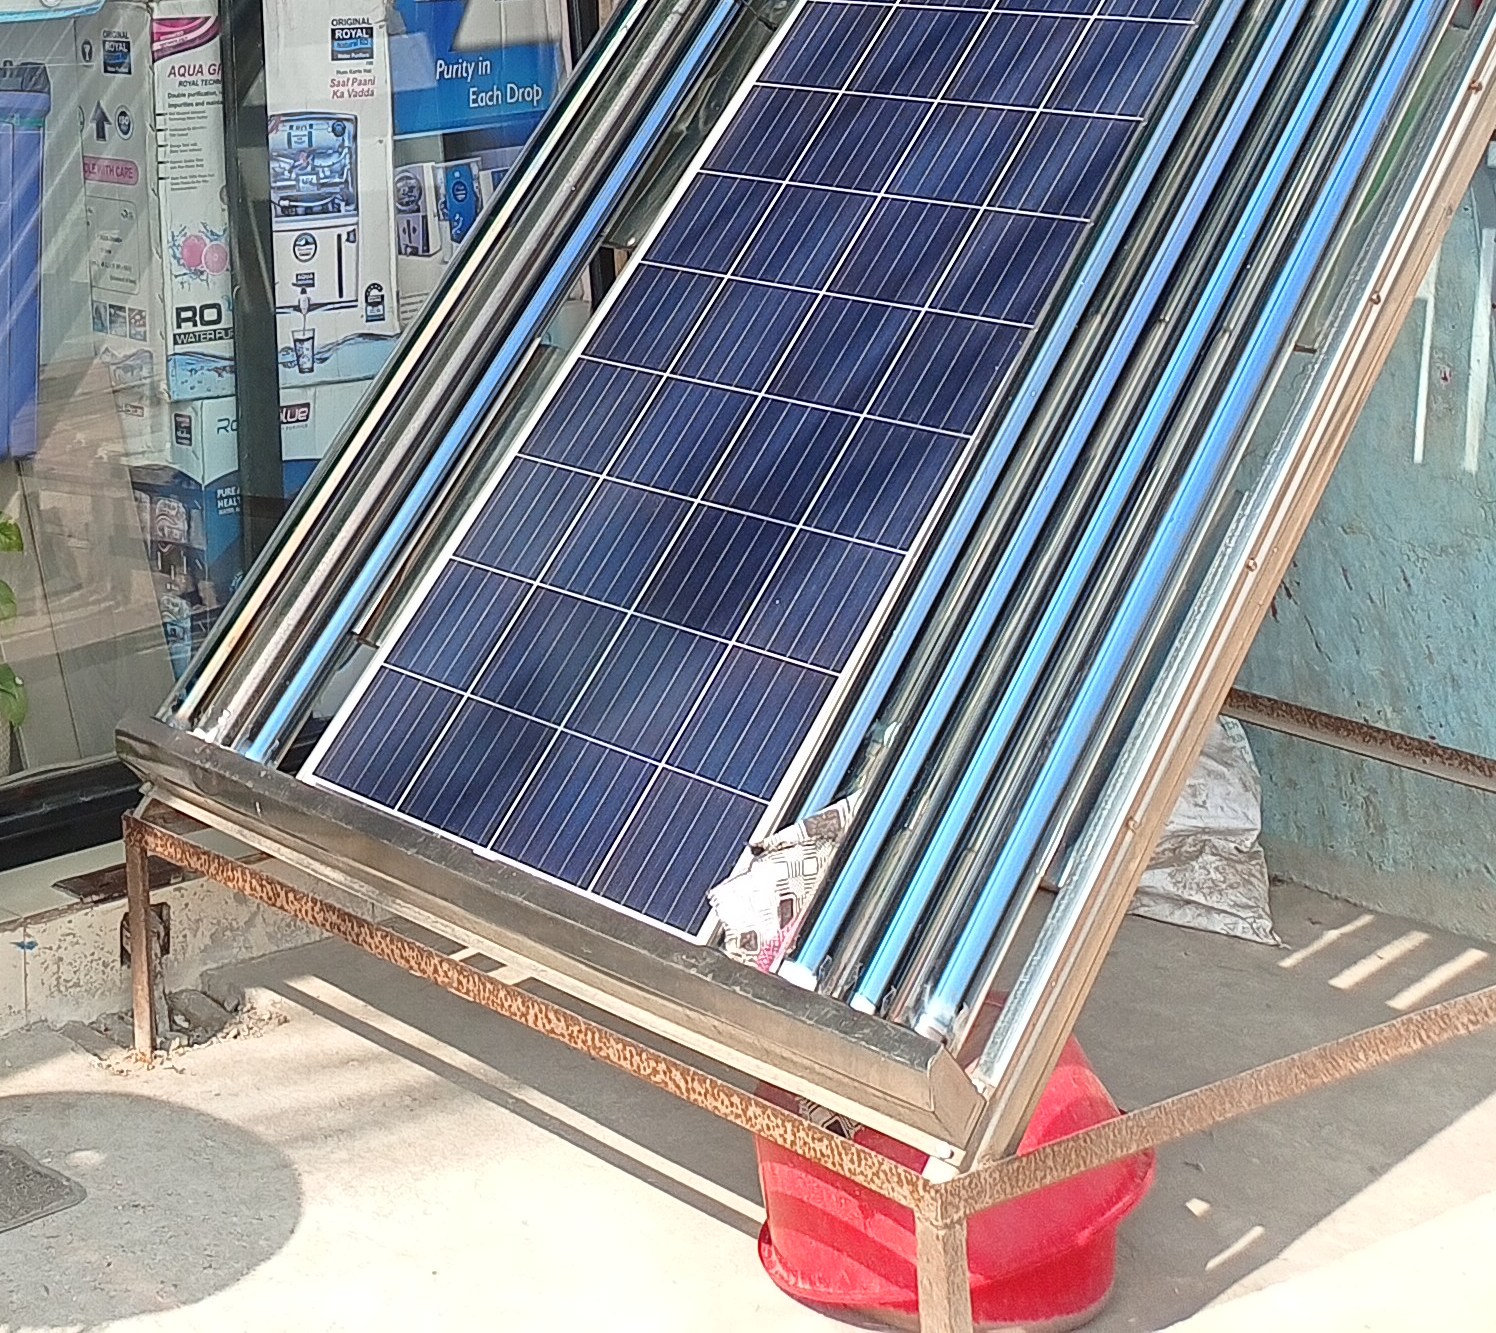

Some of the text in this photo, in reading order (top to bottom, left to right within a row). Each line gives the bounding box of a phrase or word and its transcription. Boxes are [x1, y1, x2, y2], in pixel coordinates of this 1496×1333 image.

[331, 17, 373, 27] ORIGINAL
[335, 28, 369, 40] ROYAL
[168, 63, 204, 78] AQUA
[435, 56, 491, 83] Purity in
[332, 89, 345, 100] Ka
[469, 83, 542, 108] Each Drop
[175, 302, 223, 330] RO
[175, 330, 214, 345] WATER
